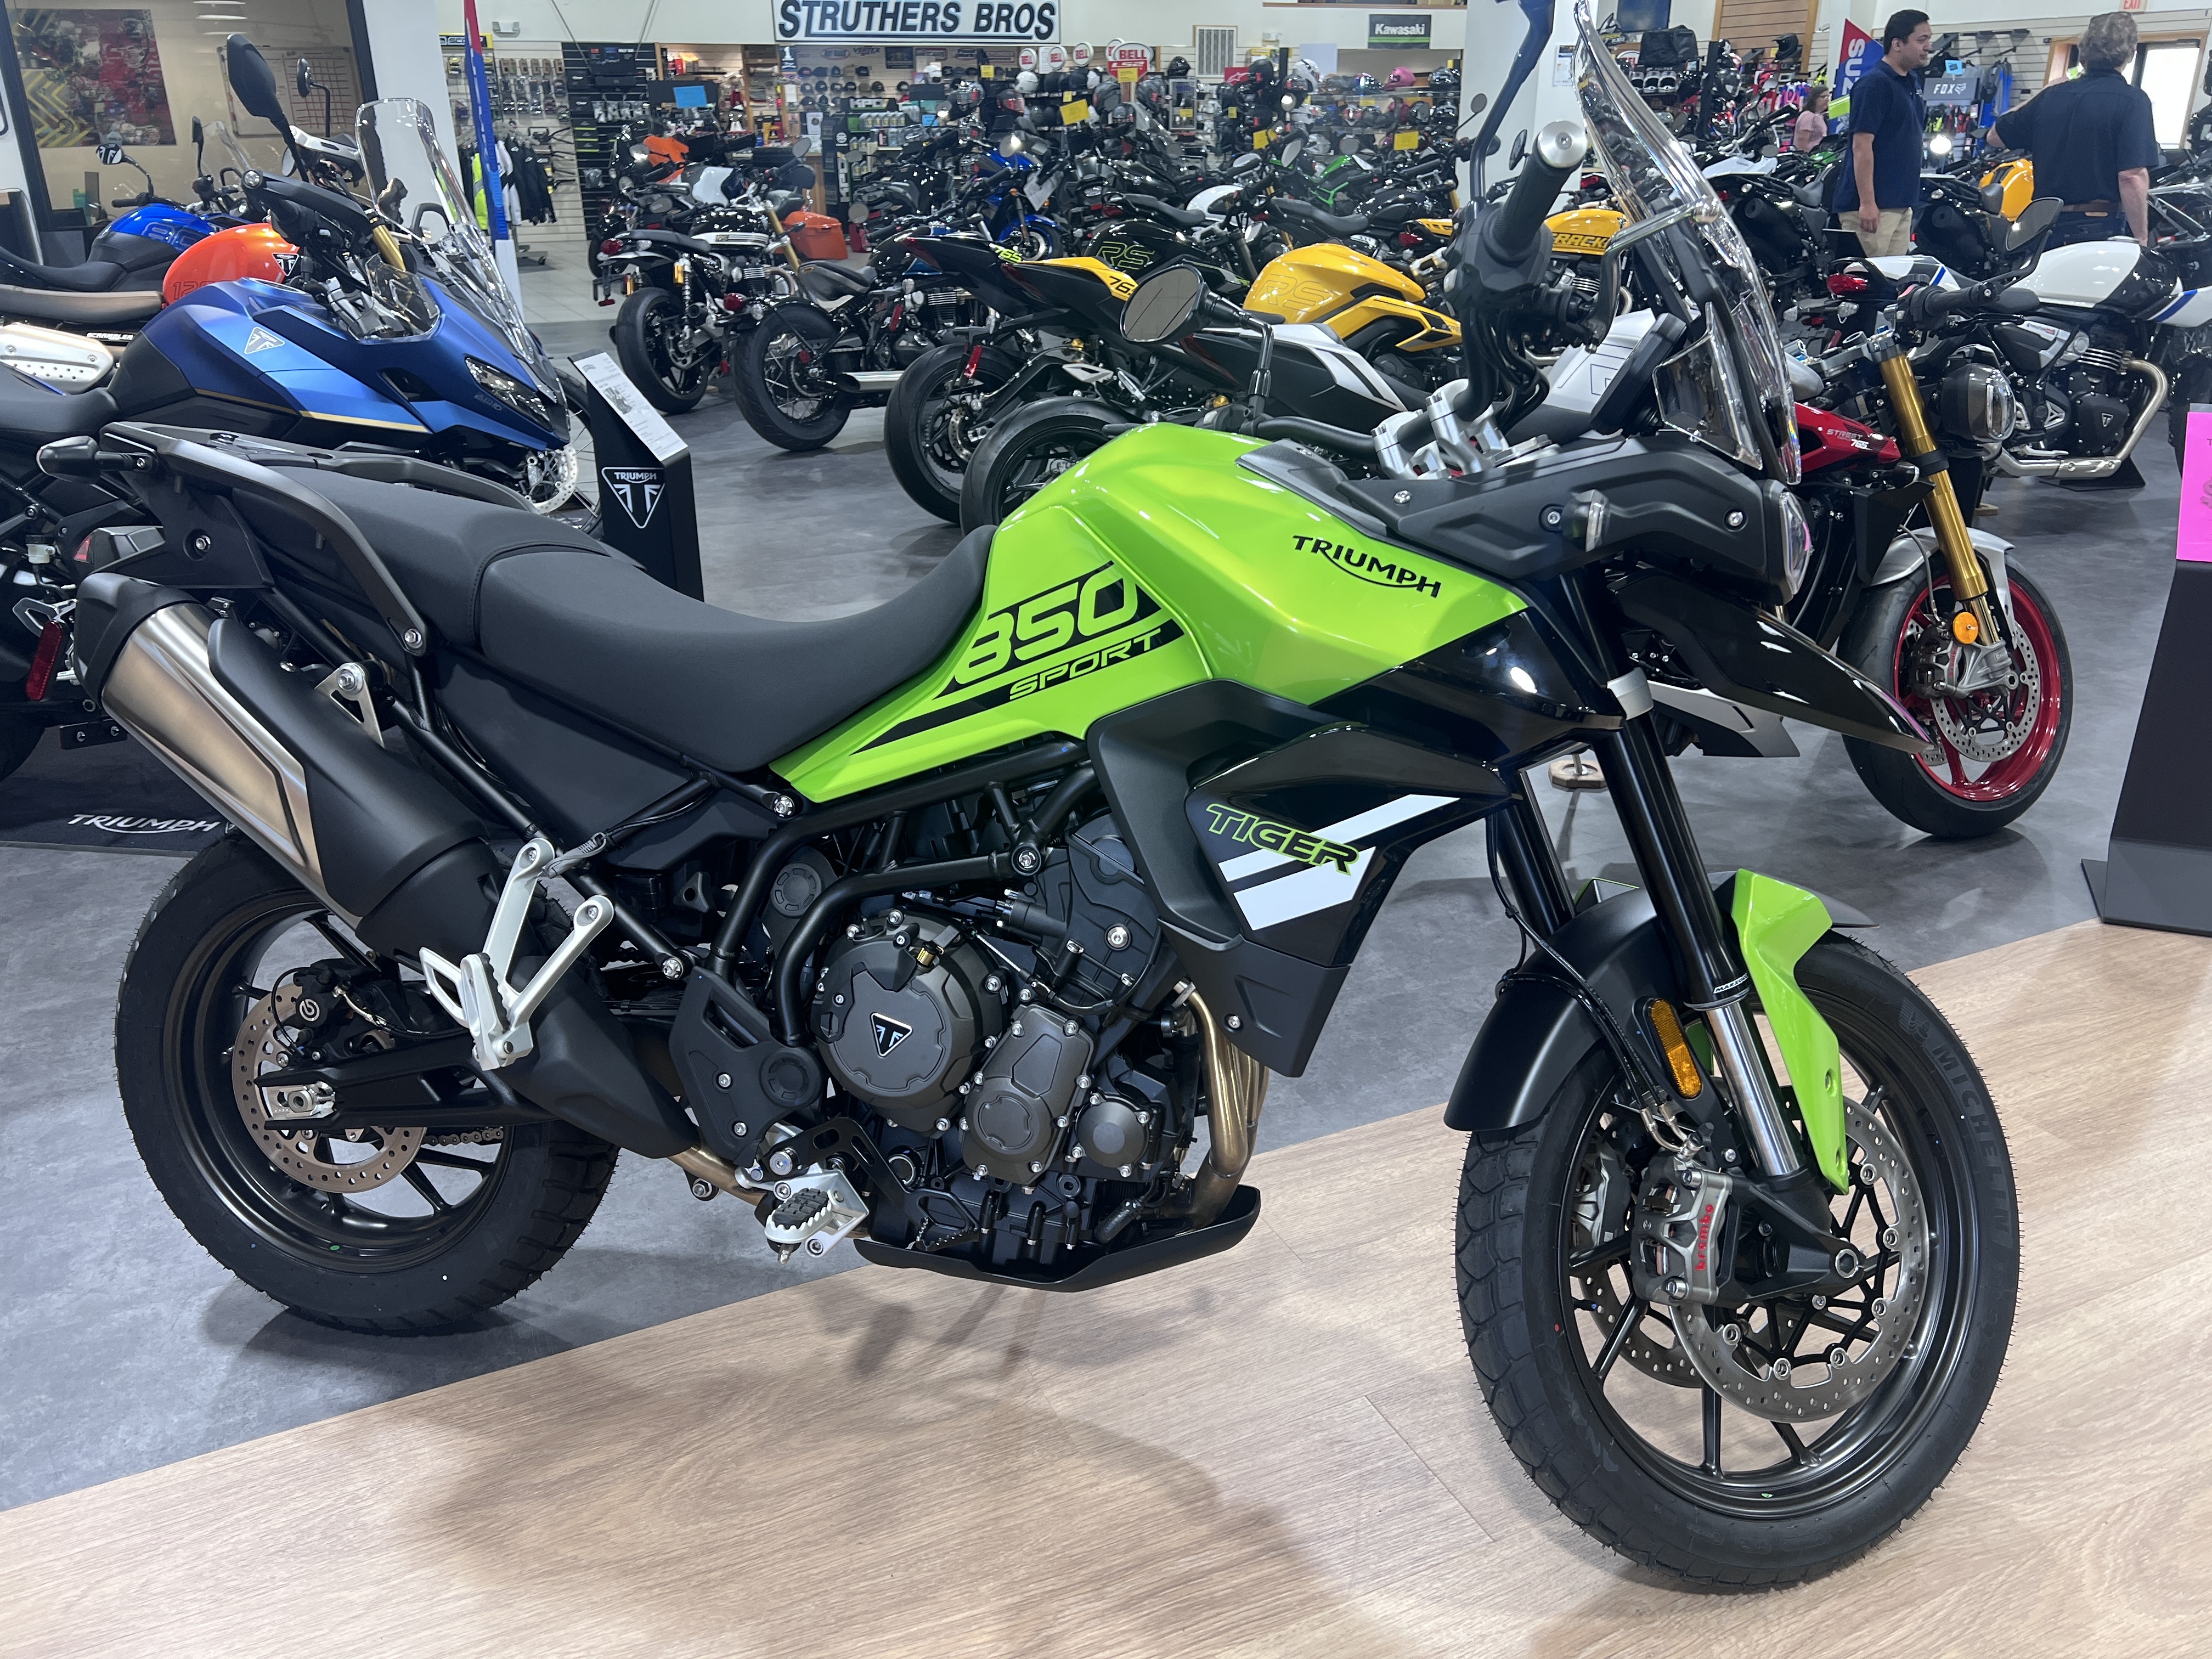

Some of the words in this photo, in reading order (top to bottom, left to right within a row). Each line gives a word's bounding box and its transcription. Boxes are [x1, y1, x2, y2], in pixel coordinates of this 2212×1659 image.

[779, 0, 961, 38] STRUTHERS
[975, 2, 1055, 40] BROS
[1374, 24, 1425, 35] Kawasaki
[1119, 49, 1147, 60] BELL
[1933, 84, 1955, 94] FOX
[1096, 241, 1155, 270] RS
[1552, 233, 1611, 249] RACK
[1109, 275, 1135, 296] 76
[1253, 273, 1333, 313] RS
[1826, 428, 1863, 439] STREET
[614, 472, 657, 483] TRIUMPH
[1292, 535, 1442, 599] TRIUMPH
[954, 568, 1138, 685] 850
[1009, 628, 1161, 700] SPORT
[67, 814, 221, 833] TRIUMPH
[1206, 803, 1359, 877] TIGER
[1931, 1045, 2011, 1235] MICHELIN
[1694, 1204, 1714, 1271] brembo
